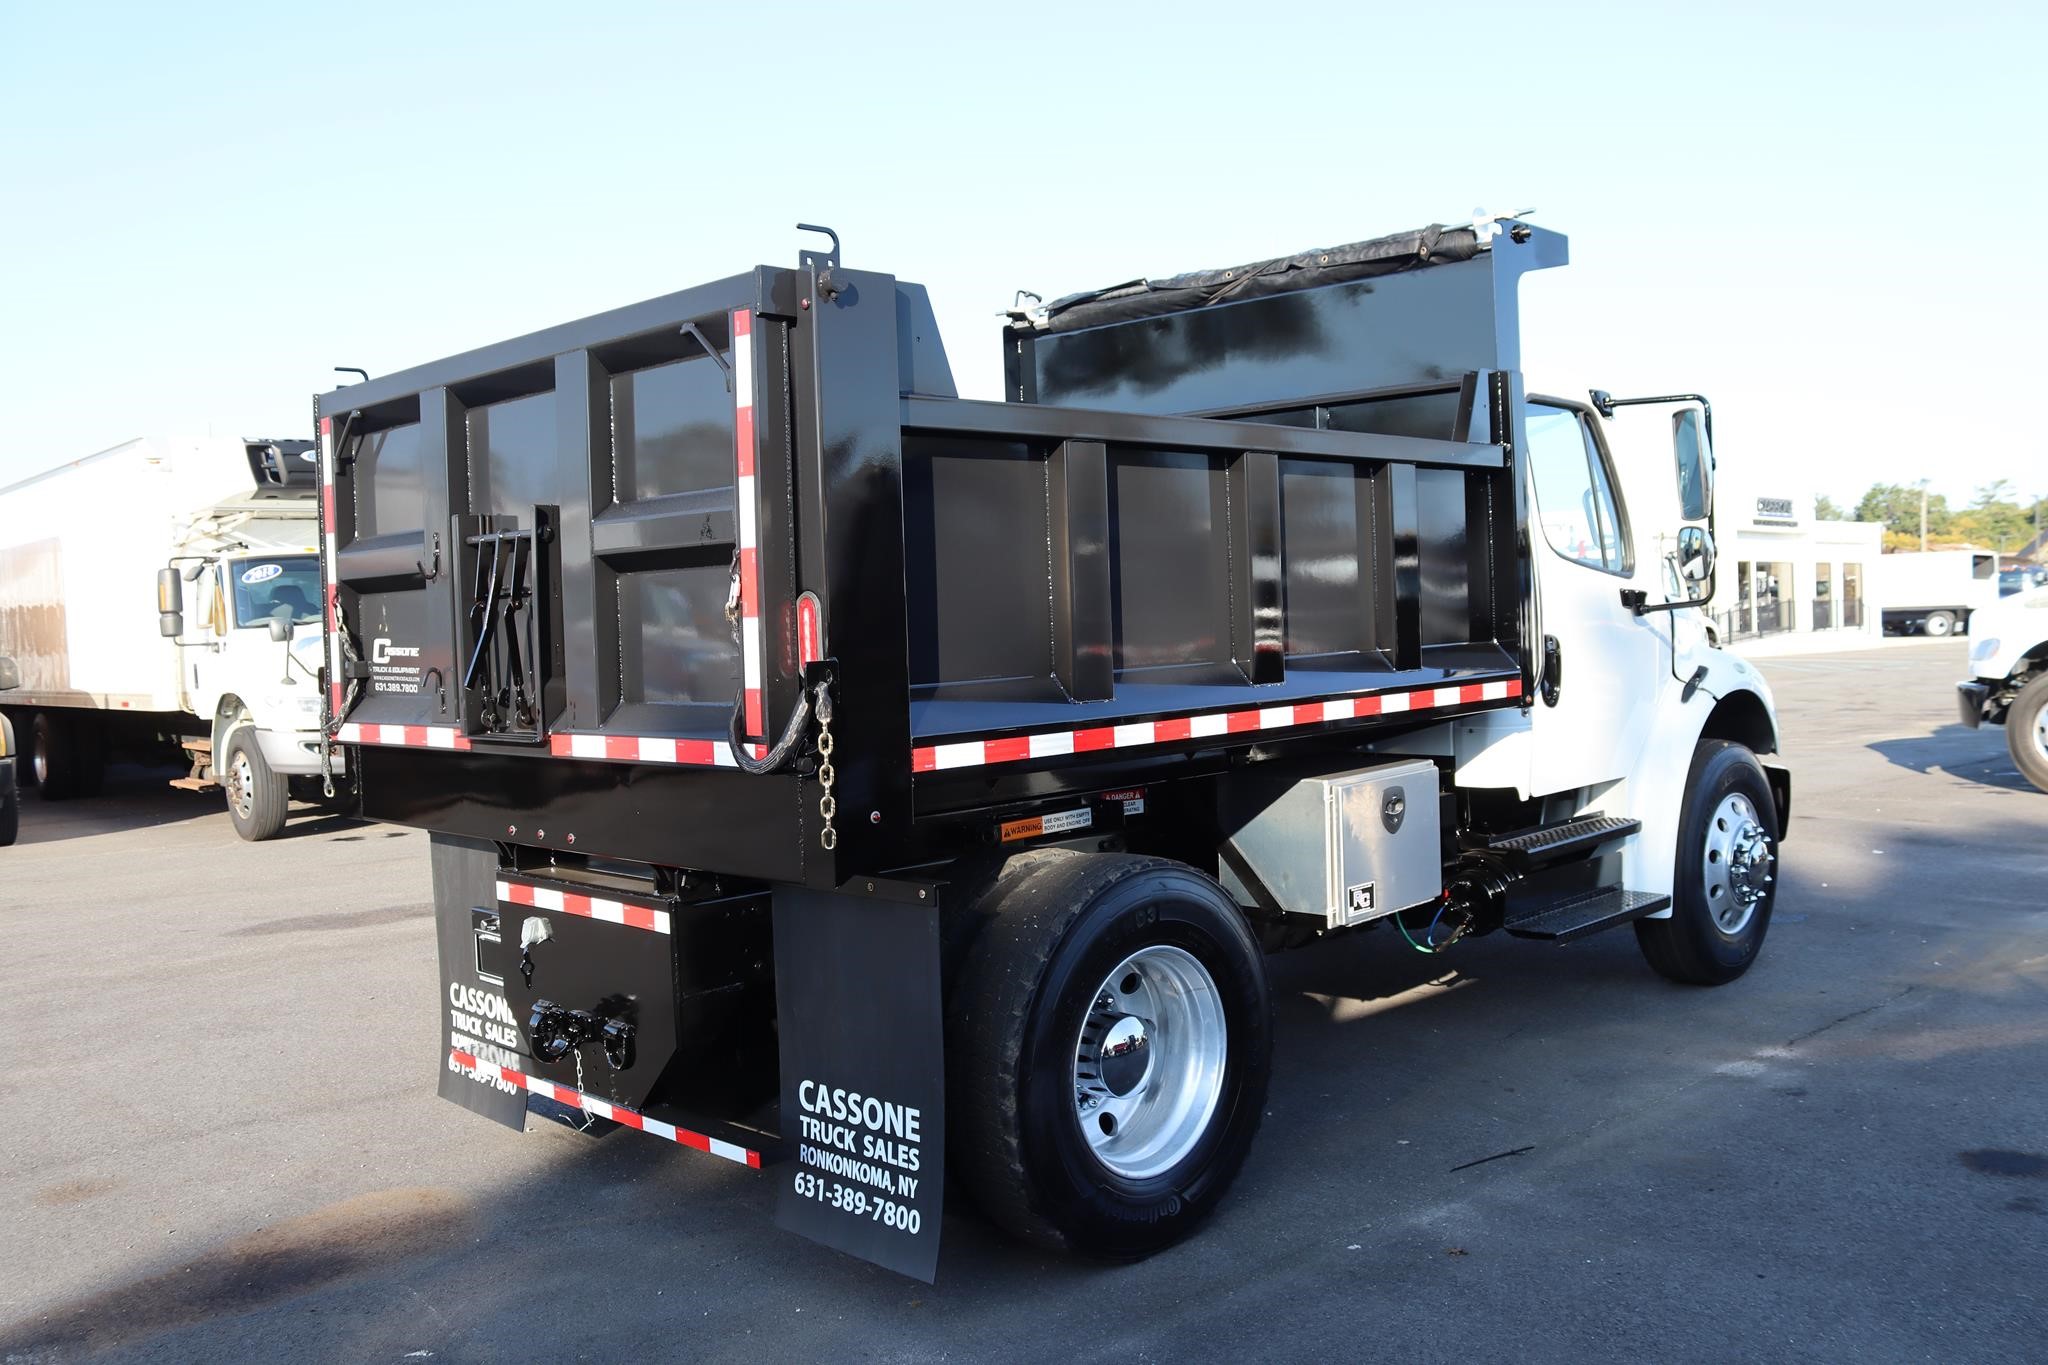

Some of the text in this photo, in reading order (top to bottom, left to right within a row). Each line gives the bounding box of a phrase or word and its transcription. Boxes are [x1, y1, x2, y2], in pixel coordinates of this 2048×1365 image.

[1011, 822, 1042, 834] WARNING
[450, 1009, 518, 1048] TRUCK SALES
[798, 1079, 921, 1143] CASSONE
[799, 1114, 920, 1172] TRUCK SALES
[799, 1143, 919, 1199] RONKONKOMA, NY
[794, 1171, 921, 1235] 631-389-7800
